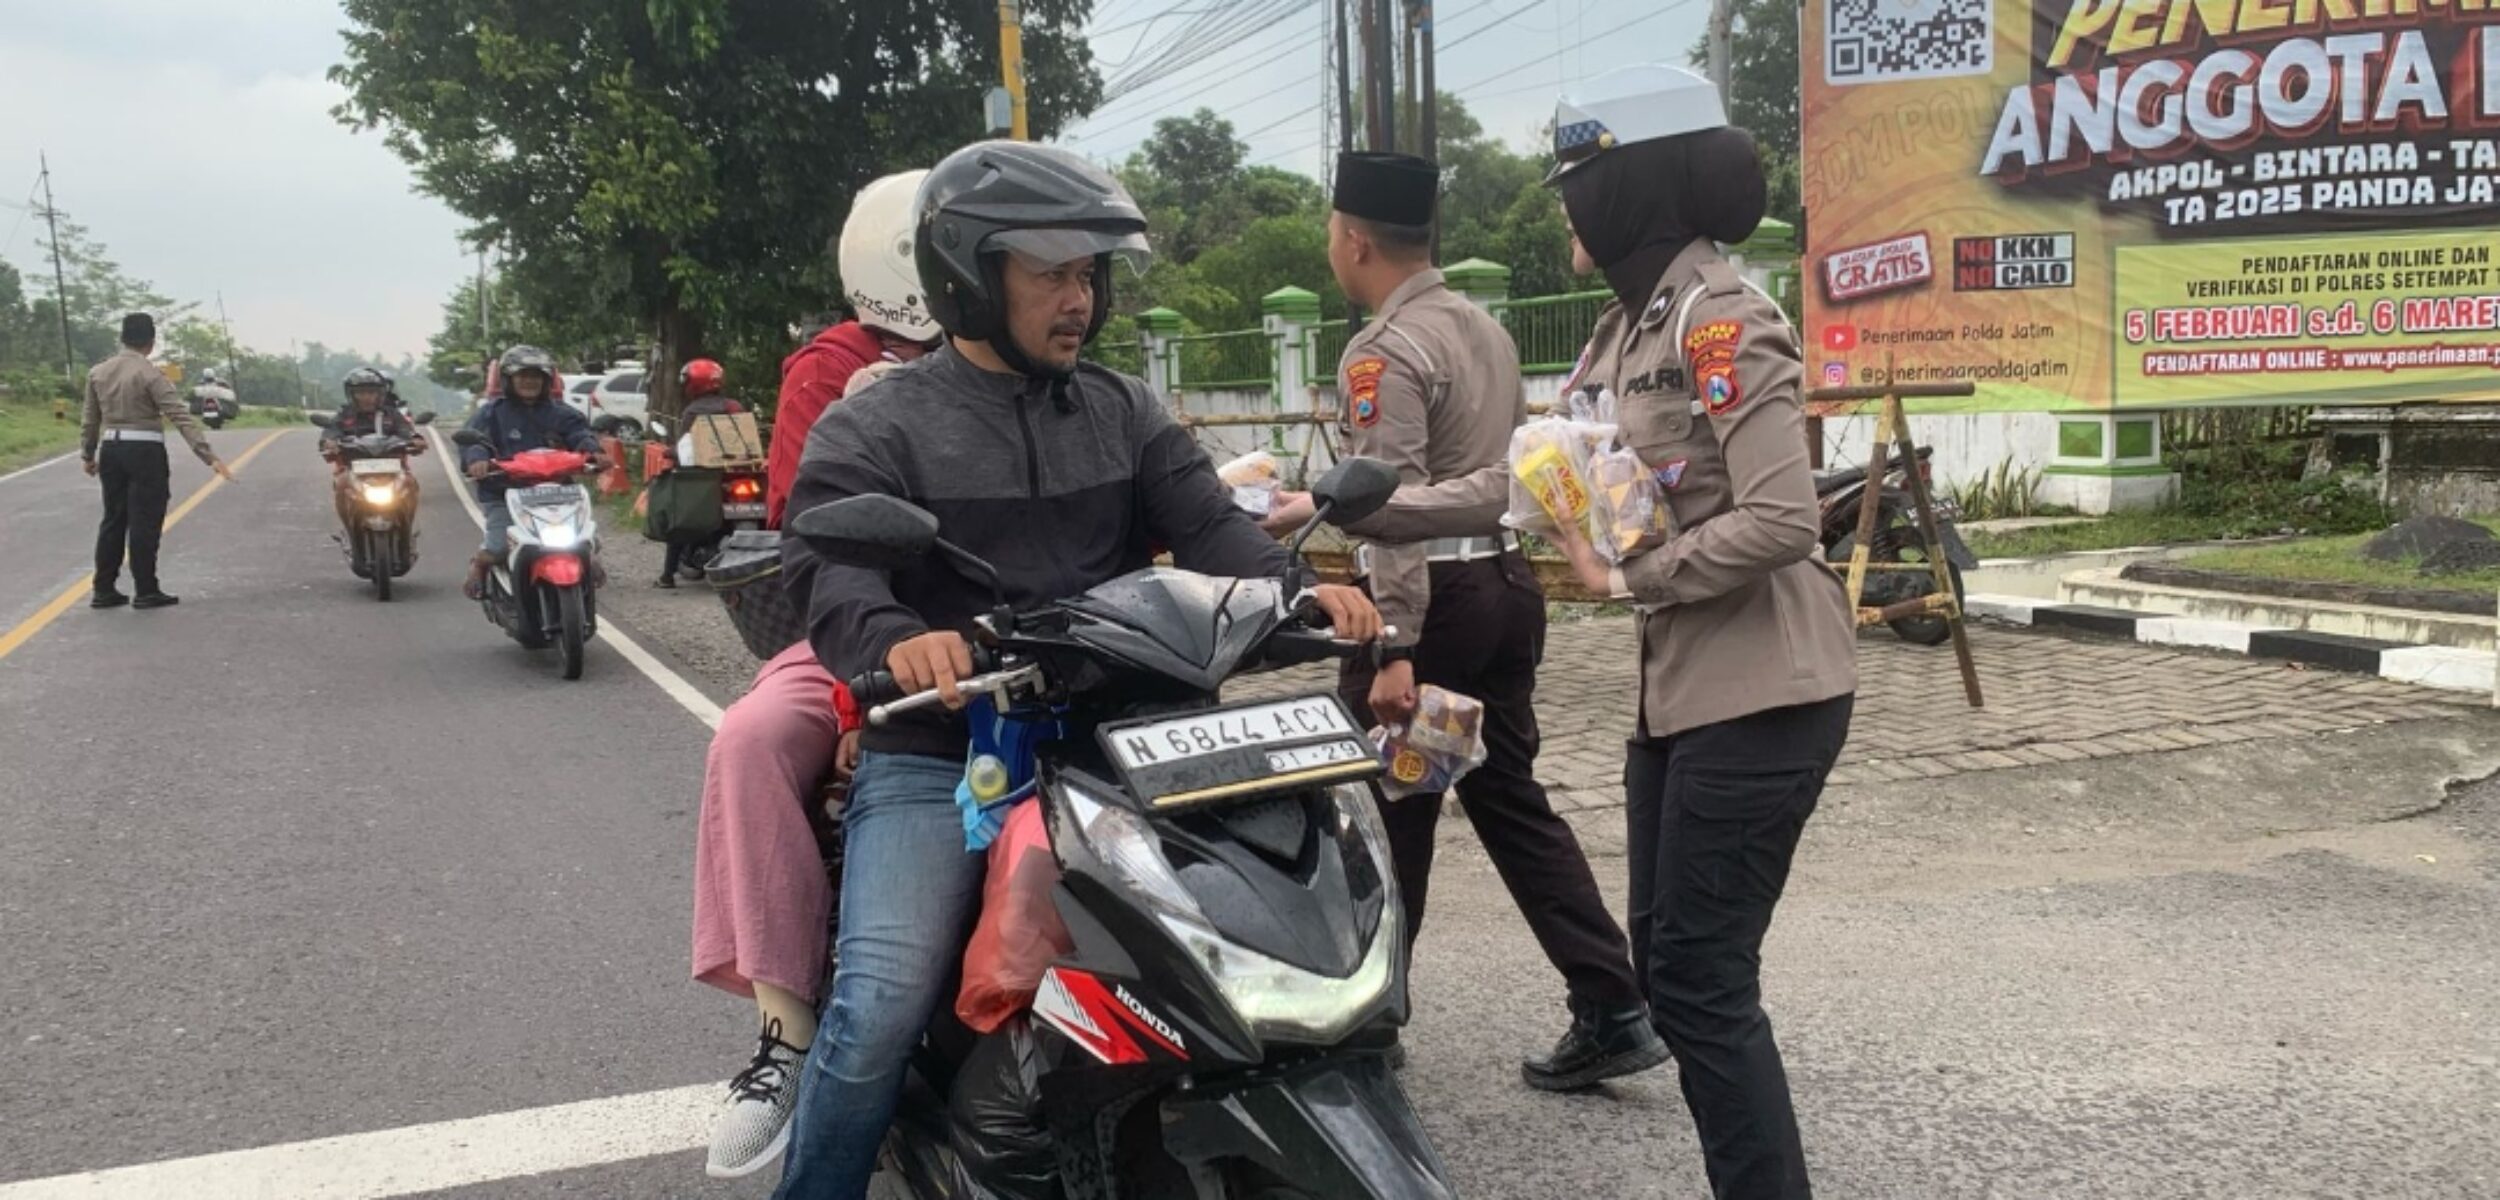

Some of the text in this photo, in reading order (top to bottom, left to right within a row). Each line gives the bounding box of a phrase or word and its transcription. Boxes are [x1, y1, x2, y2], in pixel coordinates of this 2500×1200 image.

[1980, 29, 2448, 175] ANGGOTA
[2109, 163, 2223, 201] AKPOL
[2254, 142, 2419, 181] BINTARA
[2449, 140, 2500, 169] TA
[2164, 198, 2206, 225] TA
[2215, 187, 2301, 221] 2025
[2313, 176, 2435, 210] PANDA
[1959, 237, 2055, 261] NO KKN
[2242, 246, 2489, 274] PENDAFTARAN ONLINE DAN
[1835, 251, 1925, 290] GRATIS
[1959, 263, 2067, 287] NO CALO
[2187, 278, 2284, 298] VERIFIKASI
[2291, 275, 2309, 293] DI
[2316, 273, 2385, 293] POLRES
[2393, 268, 2489, 289] SETEMPAT
[1861, 323, 2055, 344] Penerimaan Polda Jatim
[2127, 310, 2146, 342] 5
[2155, 305, 2301, 340] FEBRUARI
[2373, 300, 2394, 332] 6
[1861, 358, 2068, 386] @pnerimaanpoldajatim
[2146, 352, 2261, 374] PENDAFTARAN
[2266, 350, 2326, 370] ONLINE
[1126, 704, 1337, 763] N 6844 ACY
[1115, 983, 1186, 1051] HONDA
